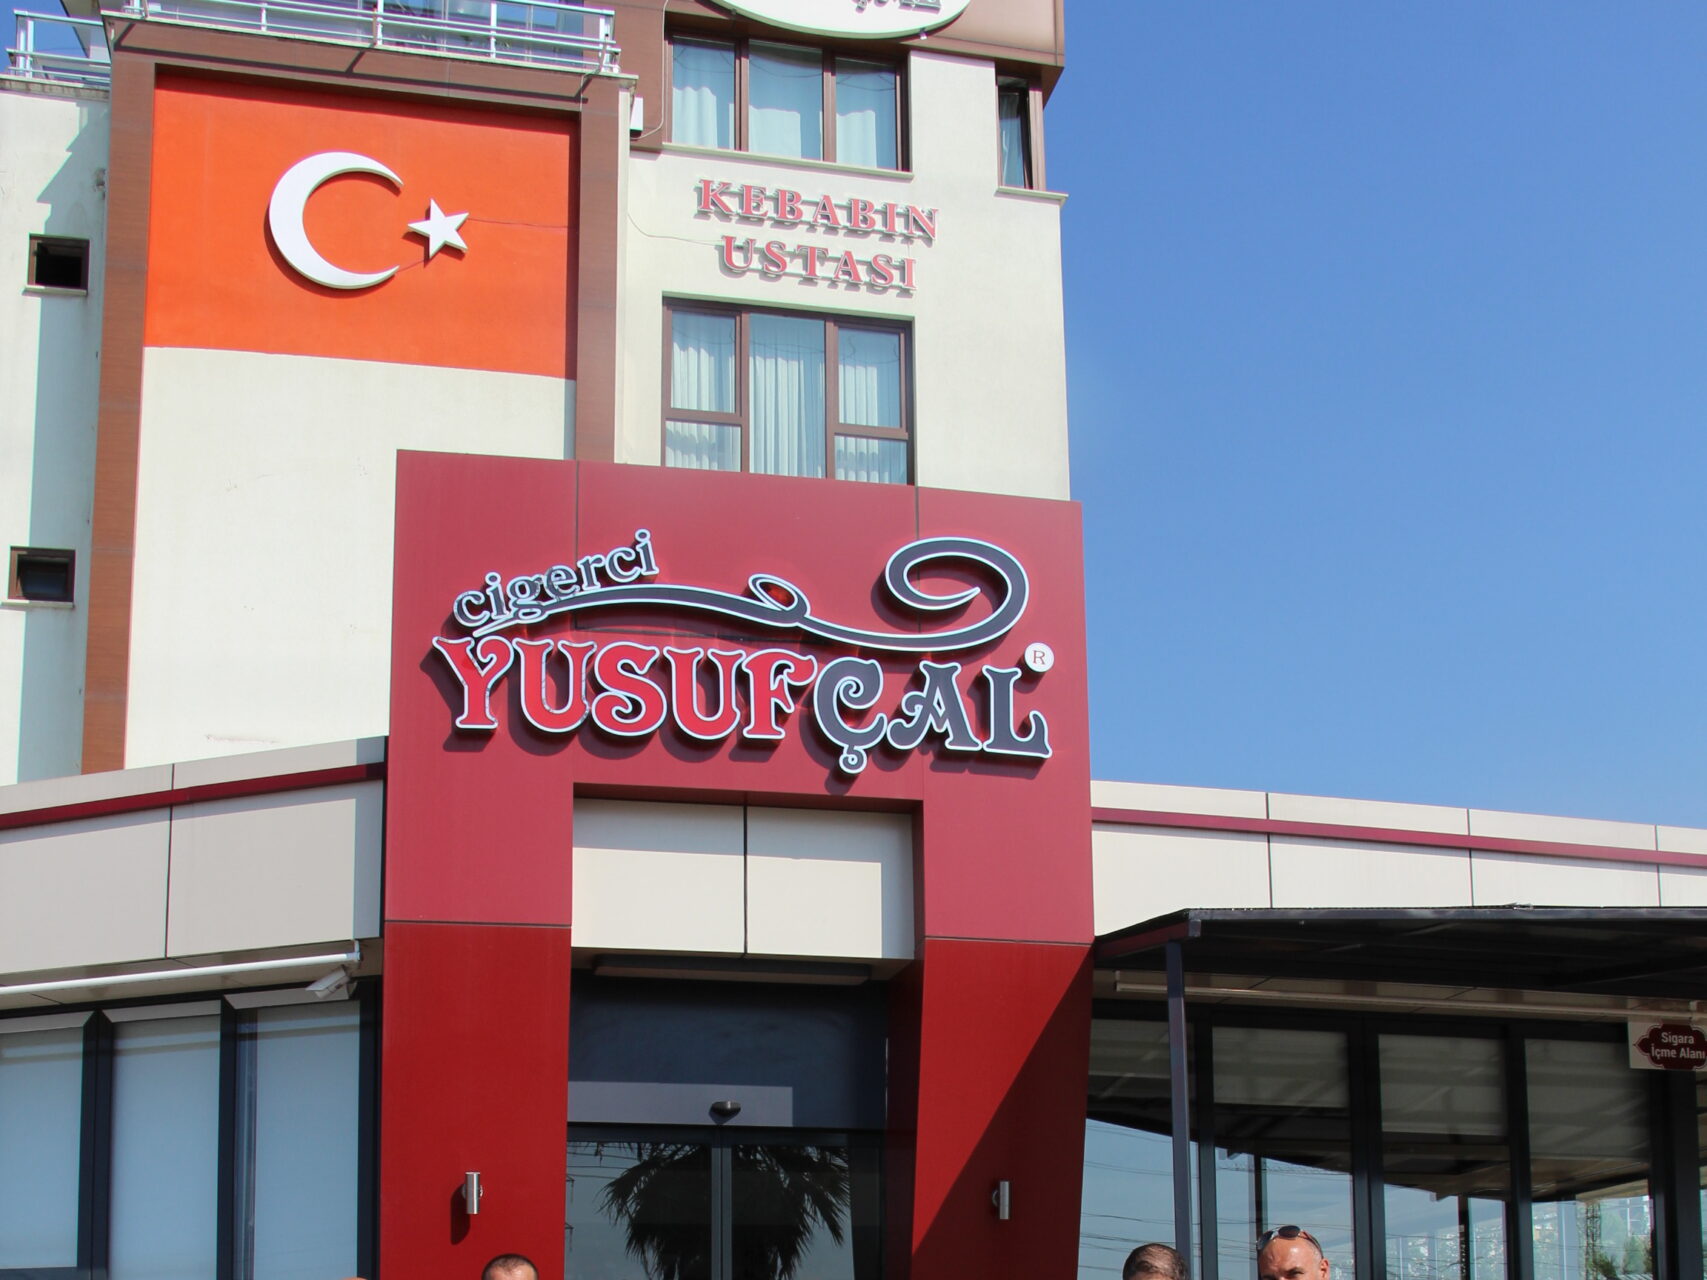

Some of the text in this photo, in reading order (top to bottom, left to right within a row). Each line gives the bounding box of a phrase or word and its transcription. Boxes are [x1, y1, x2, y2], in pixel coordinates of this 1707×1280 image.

[698, 179, 939, 241] KEBABIN
[722, 235, 917, 290] USTASI
[1651, 1043, 1706, 1059] İçme Alanı
[1661, 1032, 1695, 1046] Sigara
